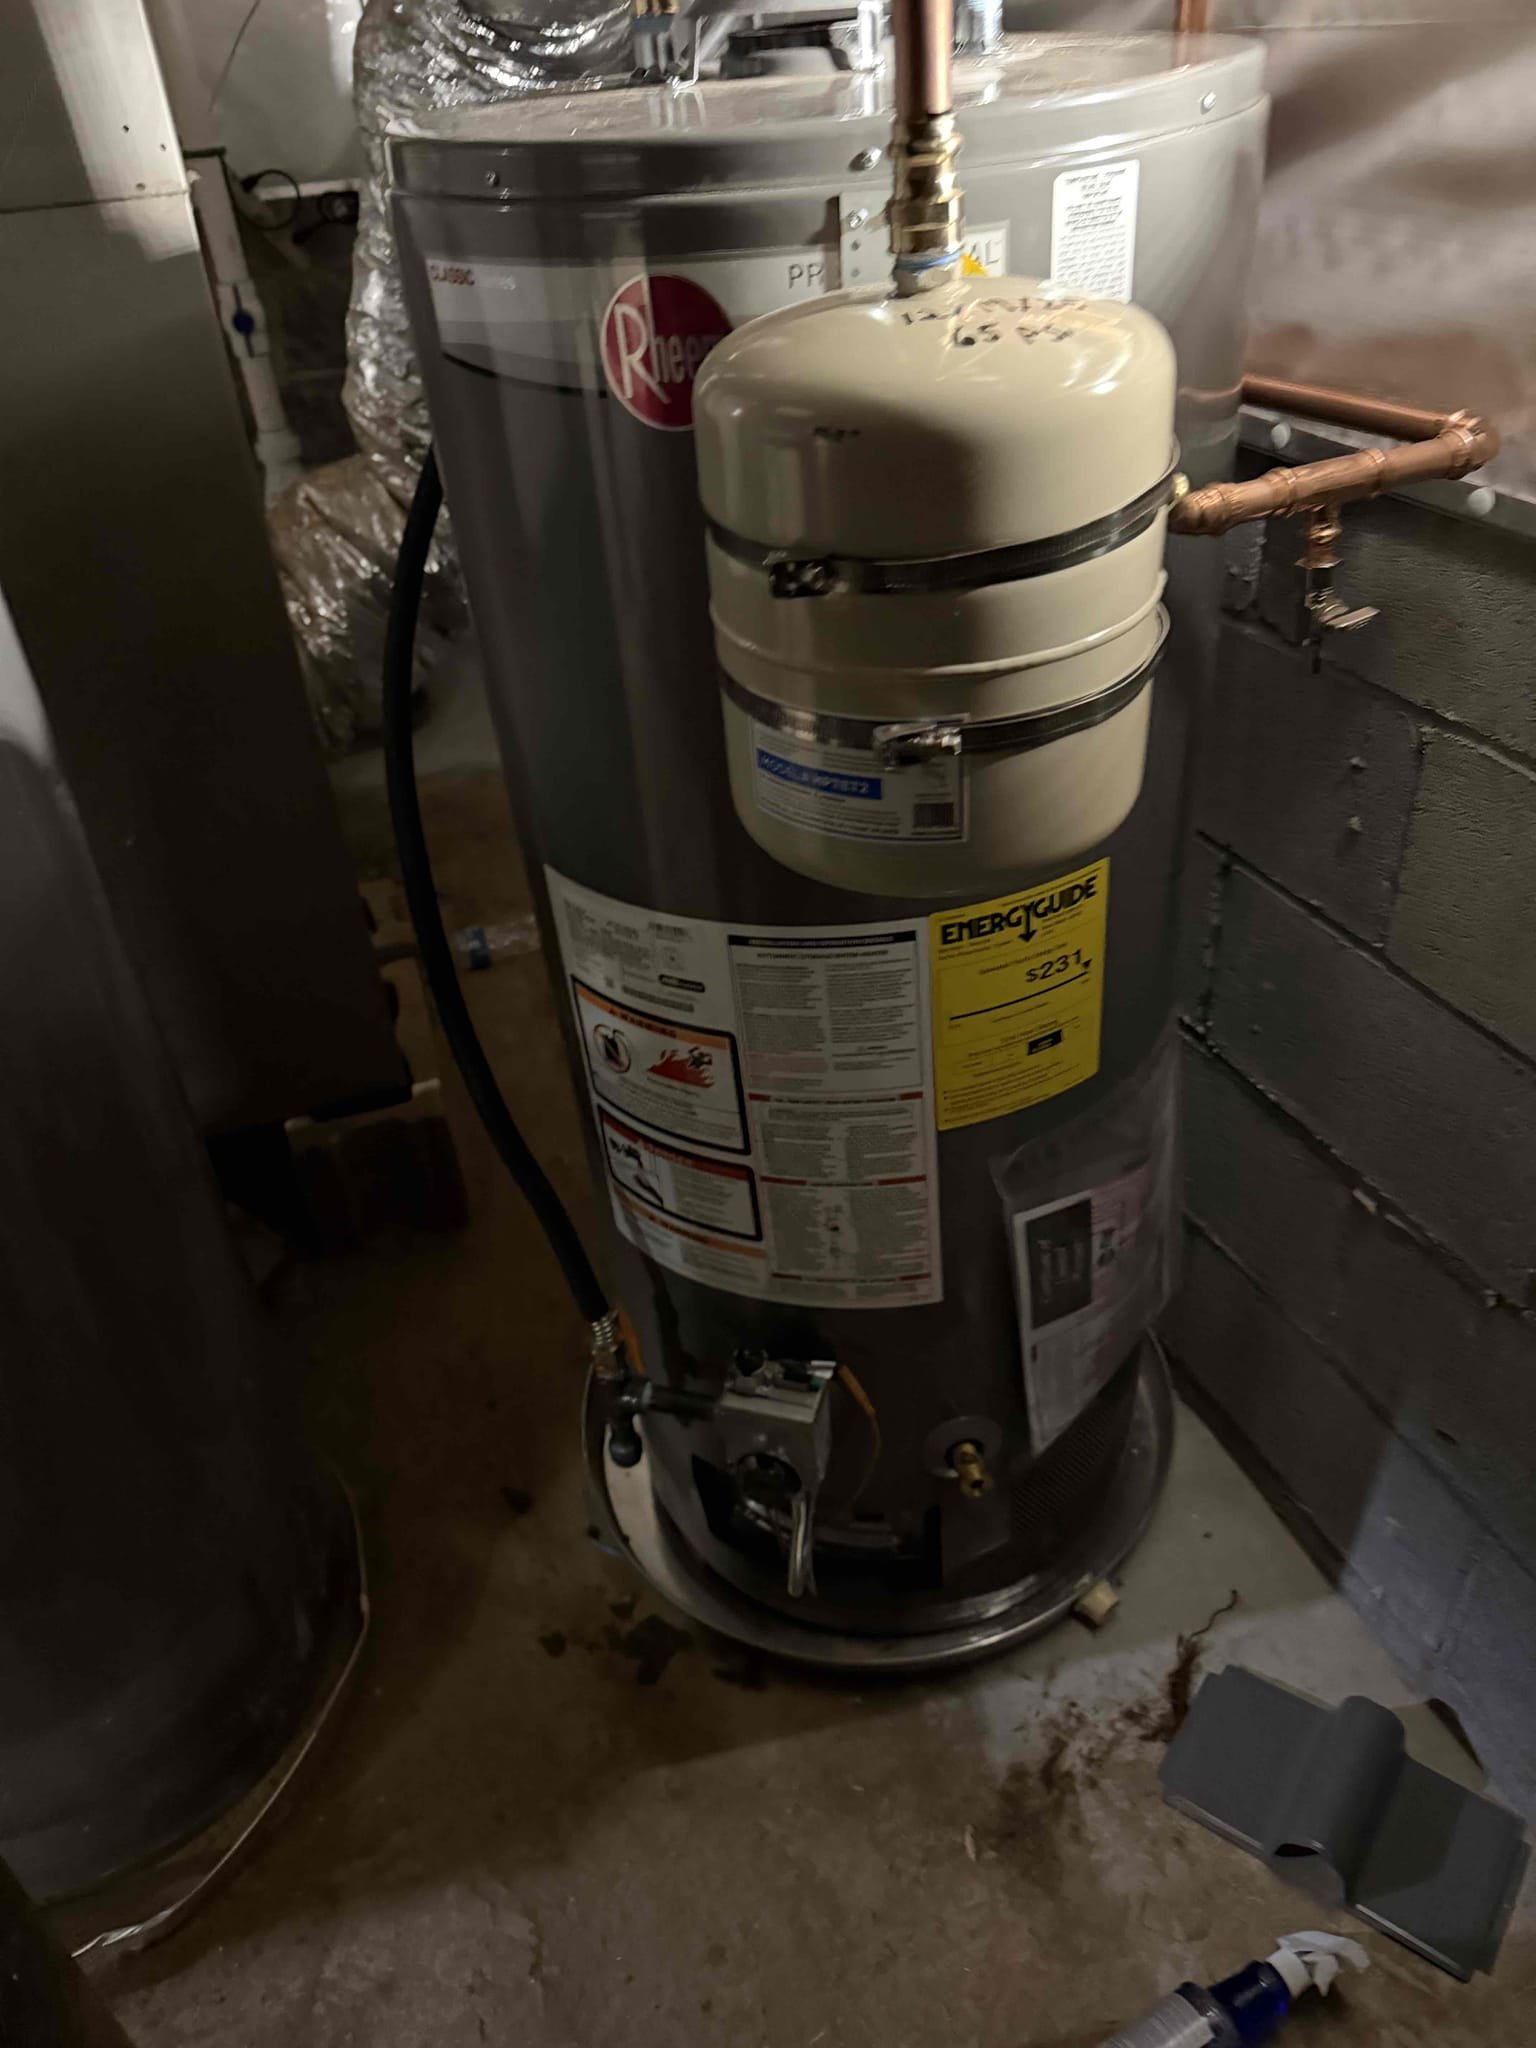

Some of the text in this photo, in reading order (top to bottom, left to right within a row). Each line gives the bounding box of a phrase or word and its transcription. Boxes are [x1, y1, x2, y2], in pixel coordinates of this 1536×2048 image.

[430, 264, 475, 286] CLASSIC
[953, 321, 1000, 348] 65
[613, 302, 716, 405] Rhee
[941, 874, 1098, 945] ENERGYGUIDE
[1025, 948, 1082, 983] $231
